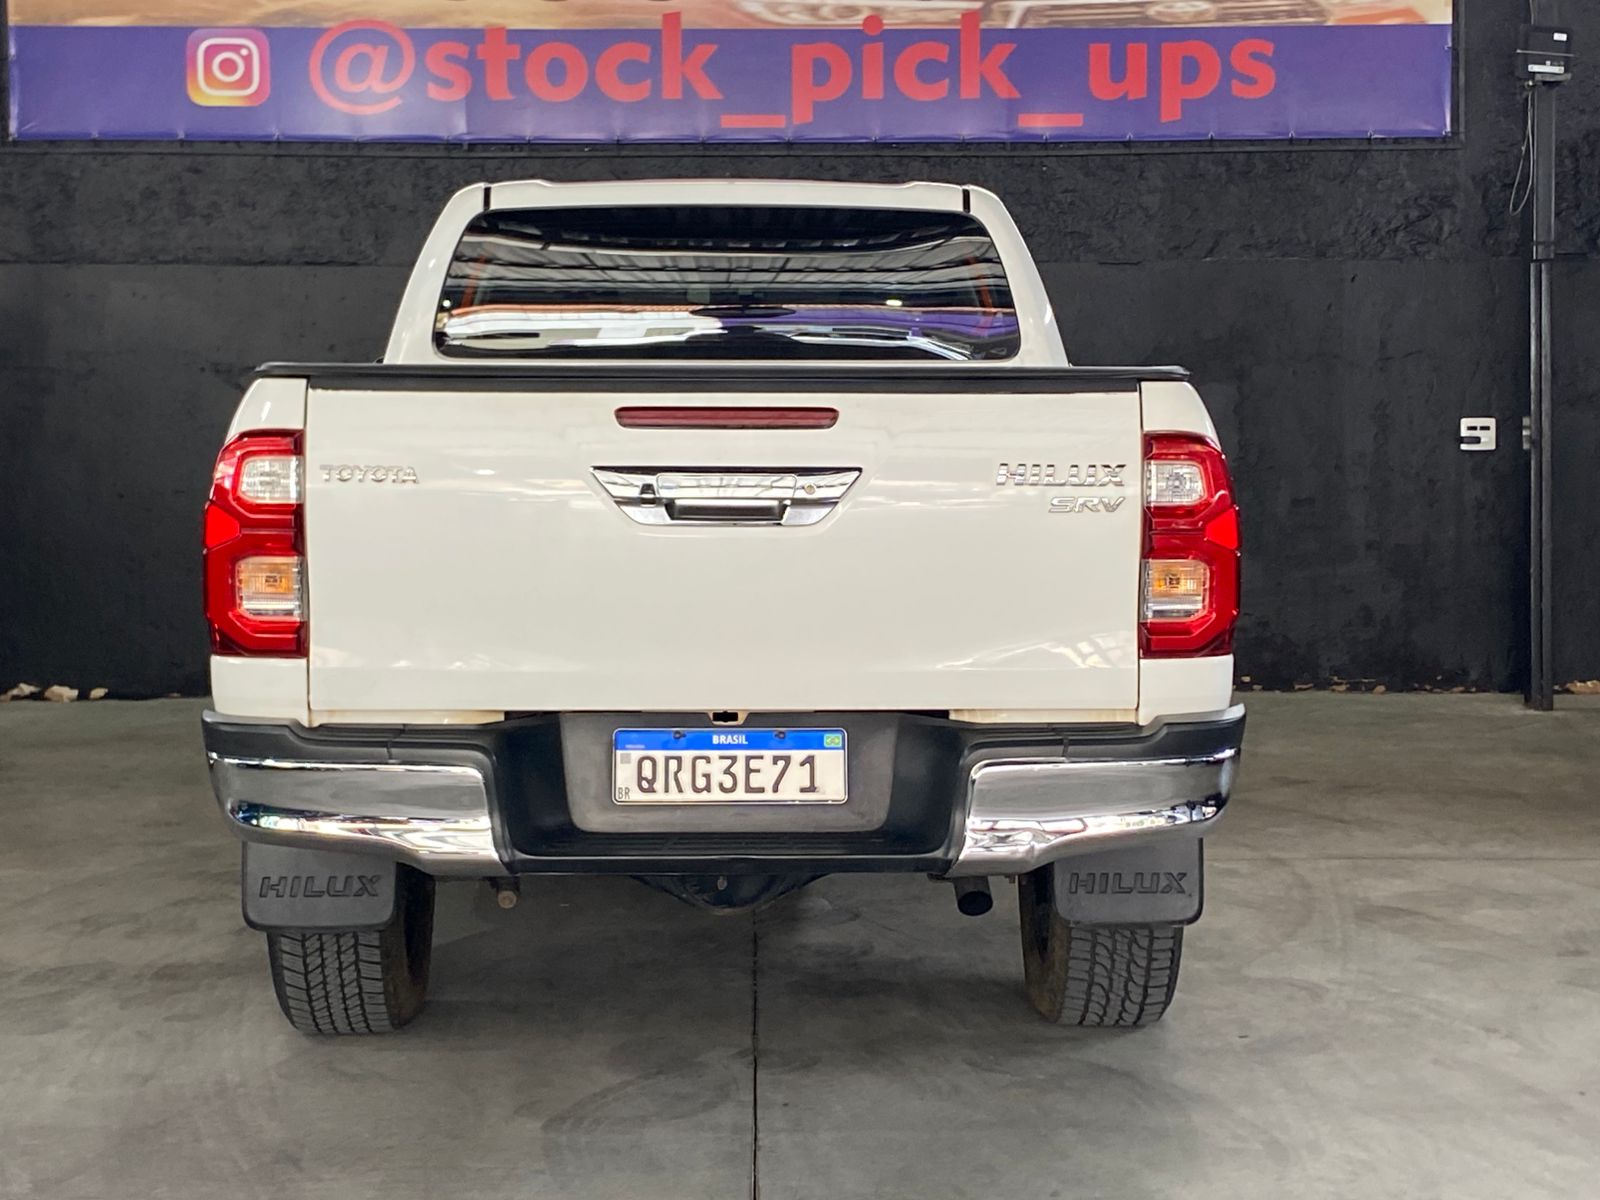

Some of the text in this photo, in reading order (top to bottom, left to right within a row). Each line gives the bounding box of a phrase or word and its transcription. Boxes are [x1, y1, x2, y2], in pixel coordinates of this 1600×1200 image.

[308, 12, 1278, 127] @stock_pick_ups
[320, 465, 418, 483] TOYOTA
[996, 463, 1127, 487] HILUX
[1048, 496, 1125, 514] SRV
[712, 735, 748, 745] BRASIL
[637, 756, 817, 793] QRG3E71
[617, 787, 631, 800] BR
[259, 875, 381, 898] HILUX
[1068, 872, 1188, 895] HILUX
